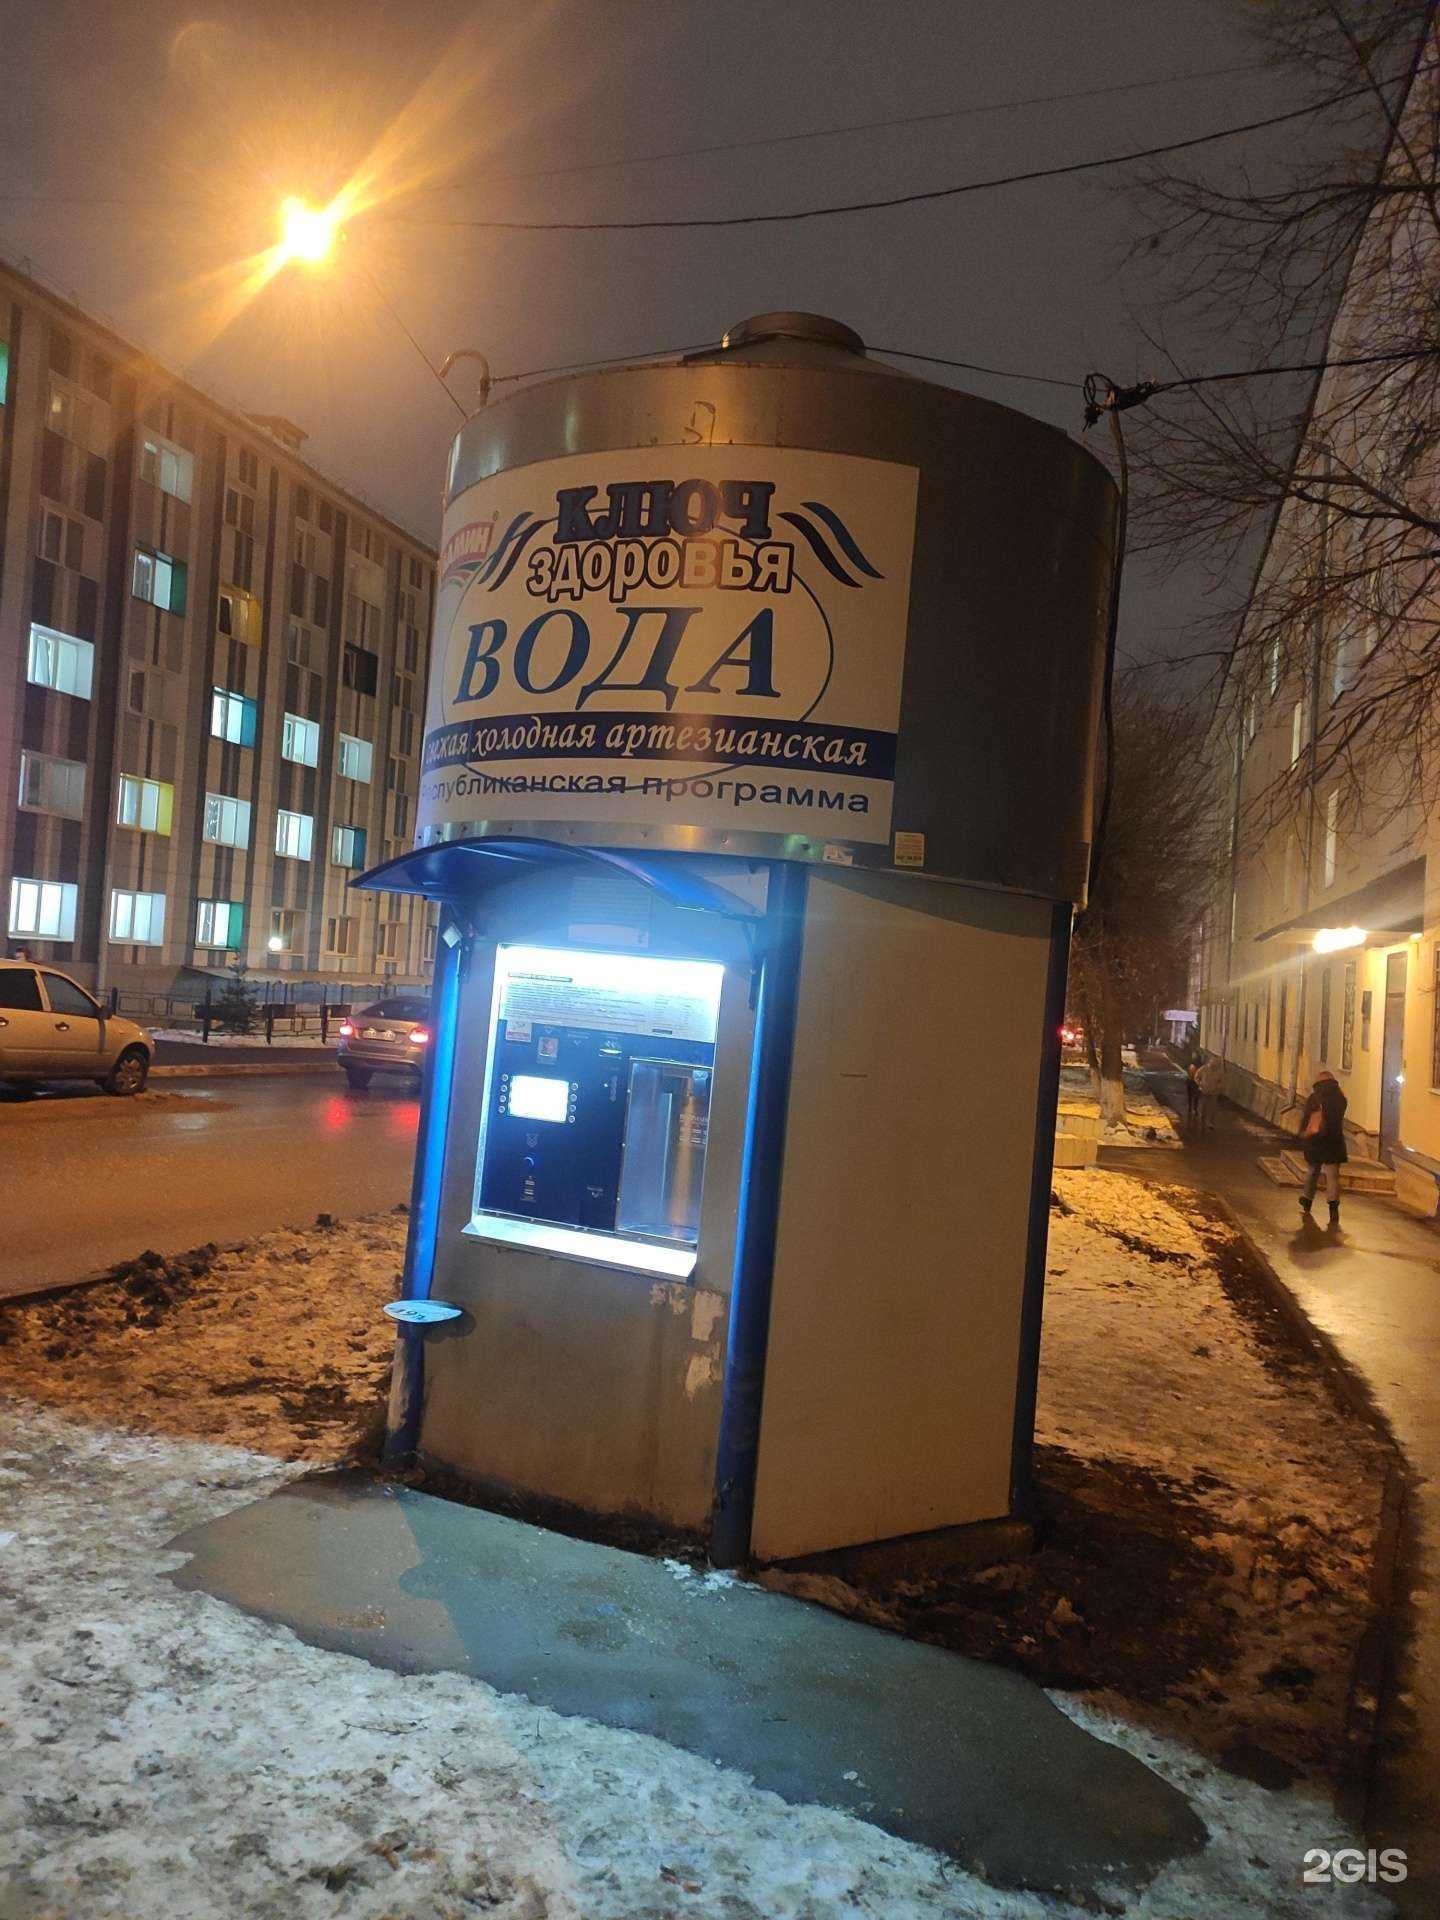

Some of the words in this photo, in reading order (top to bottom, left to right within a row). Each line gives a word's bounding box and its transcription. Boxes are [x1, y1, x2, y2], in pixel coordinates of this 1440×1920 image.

[452, 606, 782, 711] ВОДА
[471, 716, 597, 758] холодная
[604, 722, 869, 766] артезианская
[641, 776, 871, 814] программа
